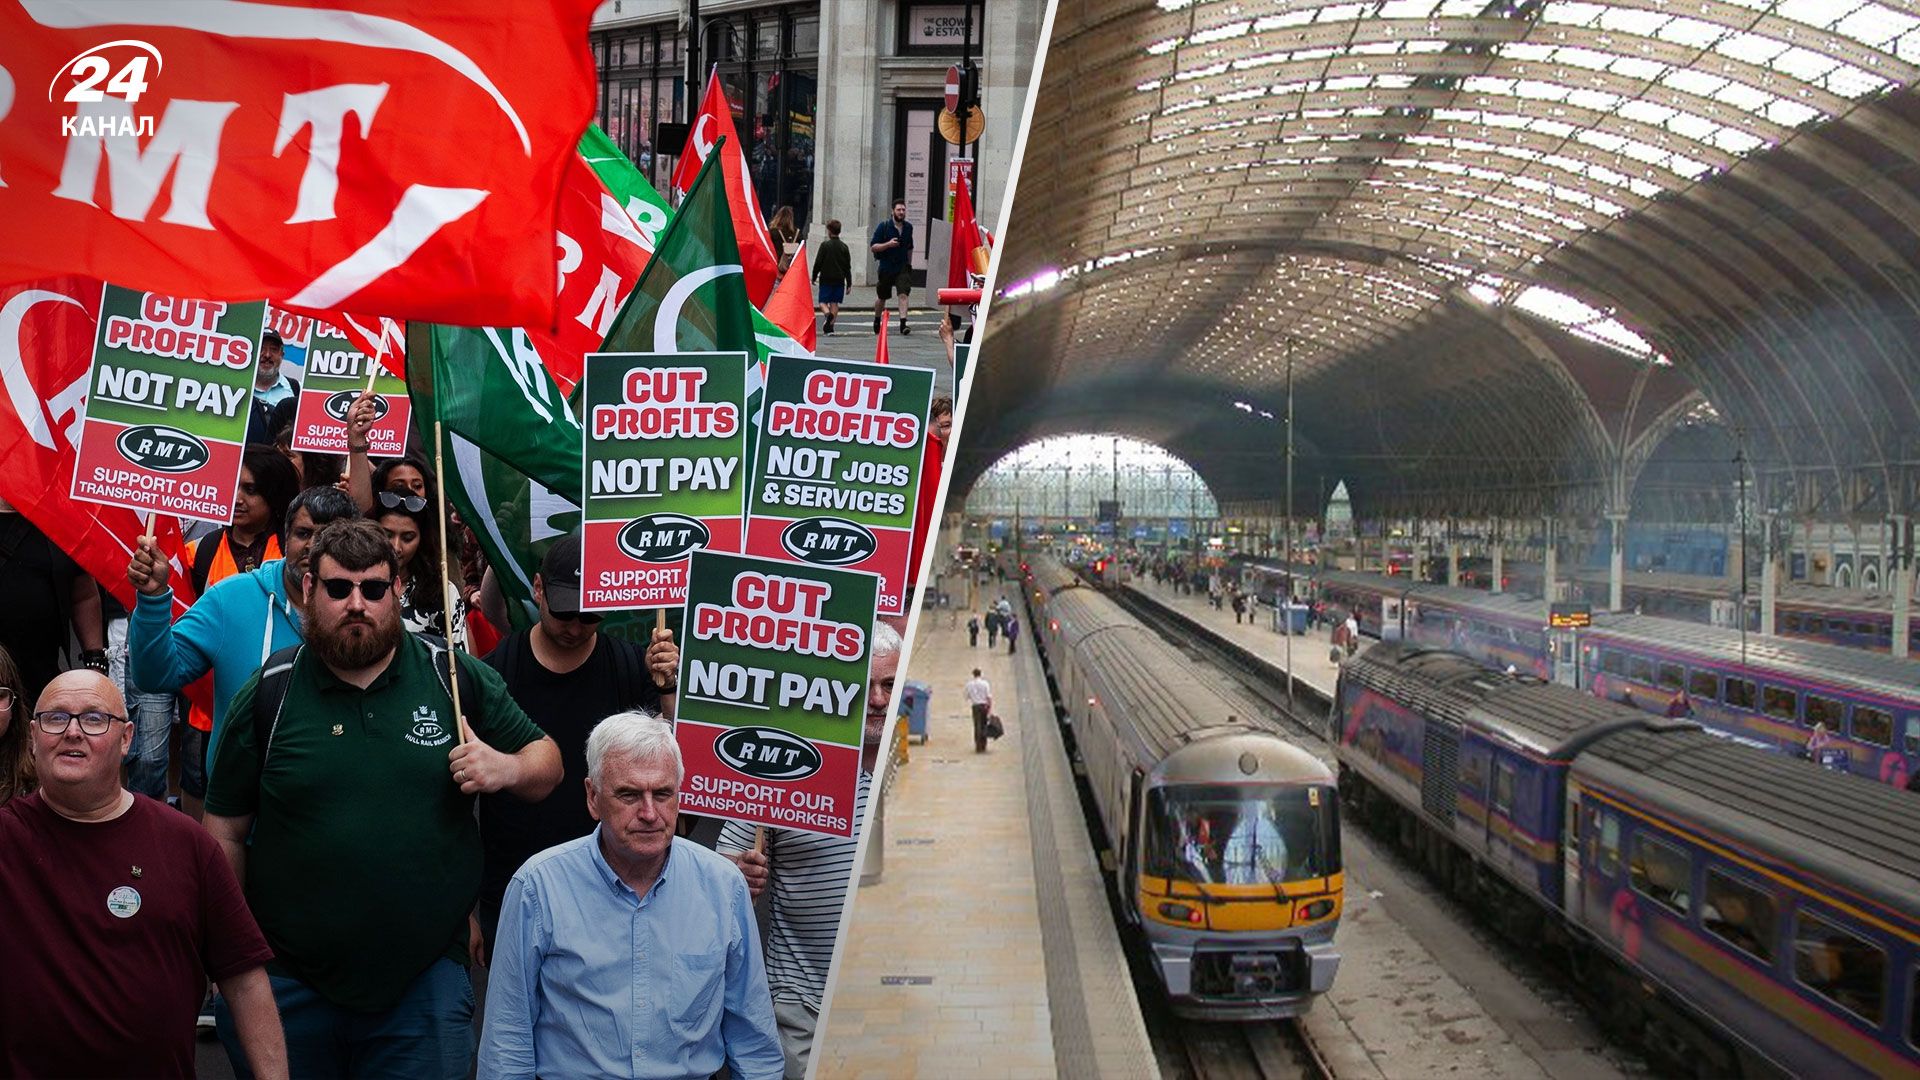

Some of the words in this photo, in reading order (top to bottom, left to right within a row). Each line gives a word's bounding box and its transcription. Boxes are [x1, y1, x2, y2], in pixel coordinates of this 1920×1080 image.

[935, 16, 974, 27] CROW
[935, 27, 973, 37] ESTAT
[0, 64, 390, 231] MT
[143, 293, 224, 332] CUT
[108, 319, 251, 366] PROFITS
[310, 350, 364, 376] NOT
[96, 364, 174, 406] NOT
[175, 377, 248, 417] PAY
[625, 370, 704, 404] CUT
[806, 373, 888, 410] CUT
[307, 424, 348, 439] SUPPO
[368, 429, 395, 441] OUR
[595, 406, 735, 437] PROFITS
[772, 410, 916, 444] PROFITS
[137, 438, 192, 461] RMT
[297, 436, 348, 449] TRANSPOR
[370, 441, 402, 452] RKERS
[591, 458, 664, 494] NOT
[669, 456, 738, 492] PAY
[767, 445, 840, 480] NOT
[842, 461, 909, 486] JOBS
[79, 481, 160, 506] TRANSPORT
[161, 496, 228, 518] WORKERS
[93, 466, 177, 494] SUPPORT
[179, 481, 218, 501] OUR
[761, 482, 781, 505] &
[784, 486, 905, 515] SERVICES
[638, 529, 692, 548] RMT
[802, 532, 858, 552] RMT
[587, 587, 667, 602] TRANSPORT
[600, 569, 682, 587] SUPPORT
[735, 576, 827, 618] CUT
[697, 608, 861, 657] PROFITS
[688, 659, 775, 703] NOT
[778, 672, 861, 717] PAY
[405, 733, 420, 745] HULL
[420, 739, 433, 747] RAIL
[420, 726, 438, 734] RMT
[739, 742, 801, 766] RMT
[690, 775, 786, 804] SUPPORT
[790, 792, 835, 812] OUR
[677, 792, 767, 817] TRANSPORT
[770, 806, 848, 831] WORKERS
